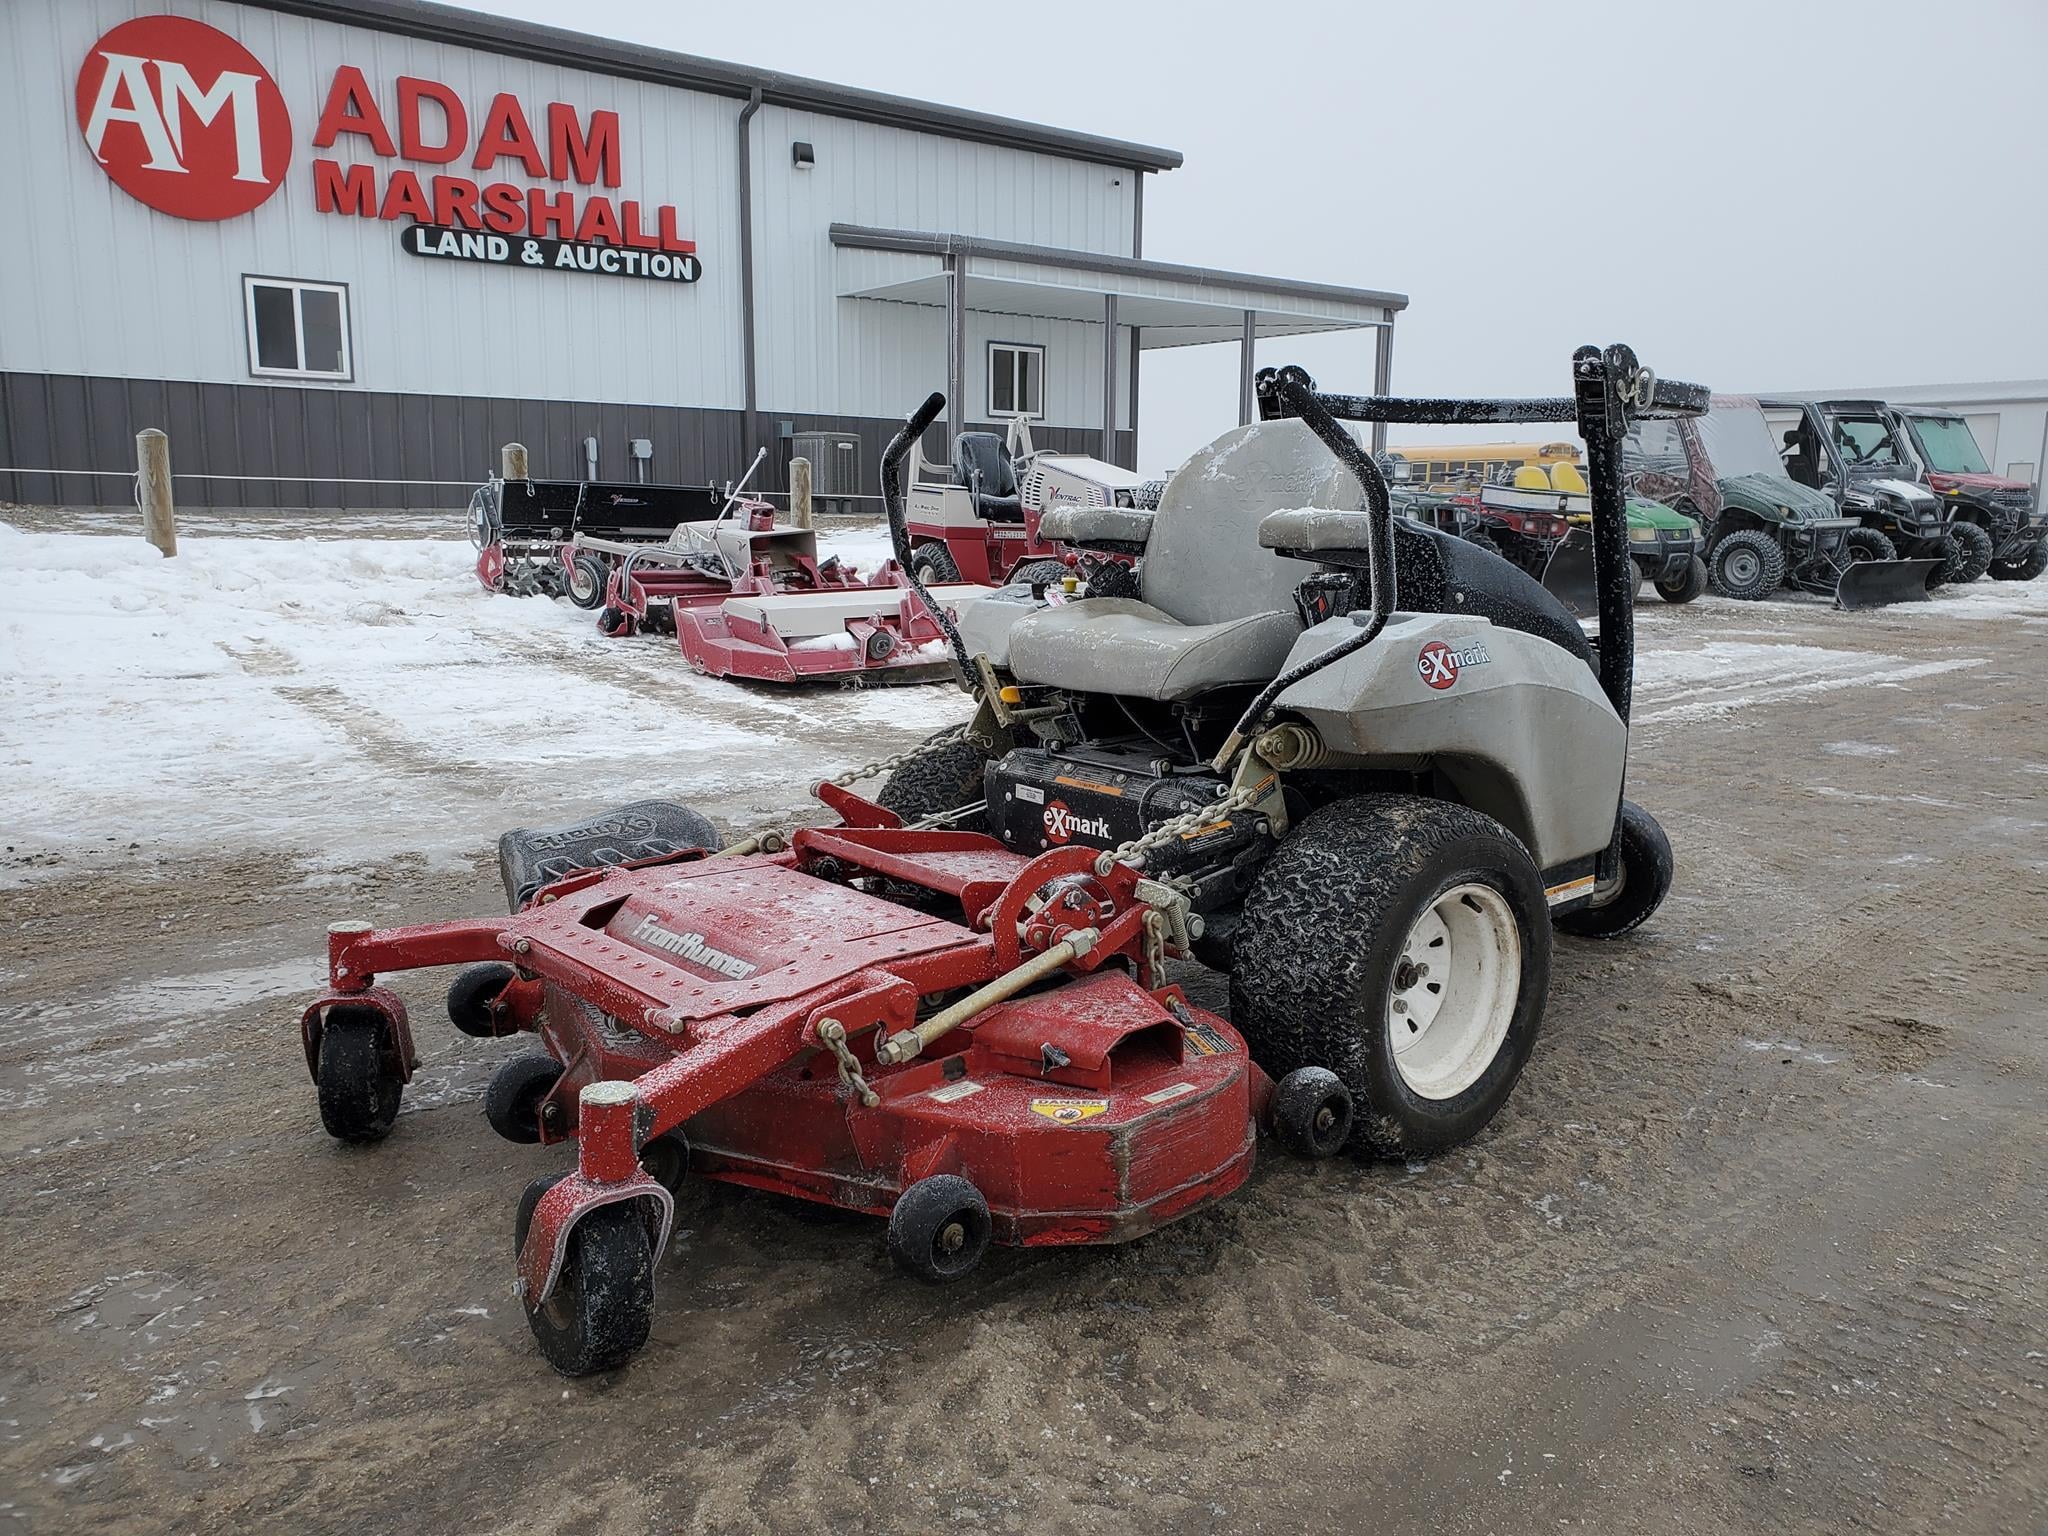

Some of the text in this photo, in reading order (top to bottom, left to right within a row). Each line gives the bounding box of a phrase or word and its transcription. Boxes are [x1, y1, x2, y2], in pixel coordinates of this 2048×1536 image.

[85, 52, 271, 184] AM
[312, 65, 621, 188] ADAM
[313, 159, 696, 253] MARSHALL
[416, 228, 693, 281] LAND & AUCTION
[632, 913, 757, 980] FrontRunner
